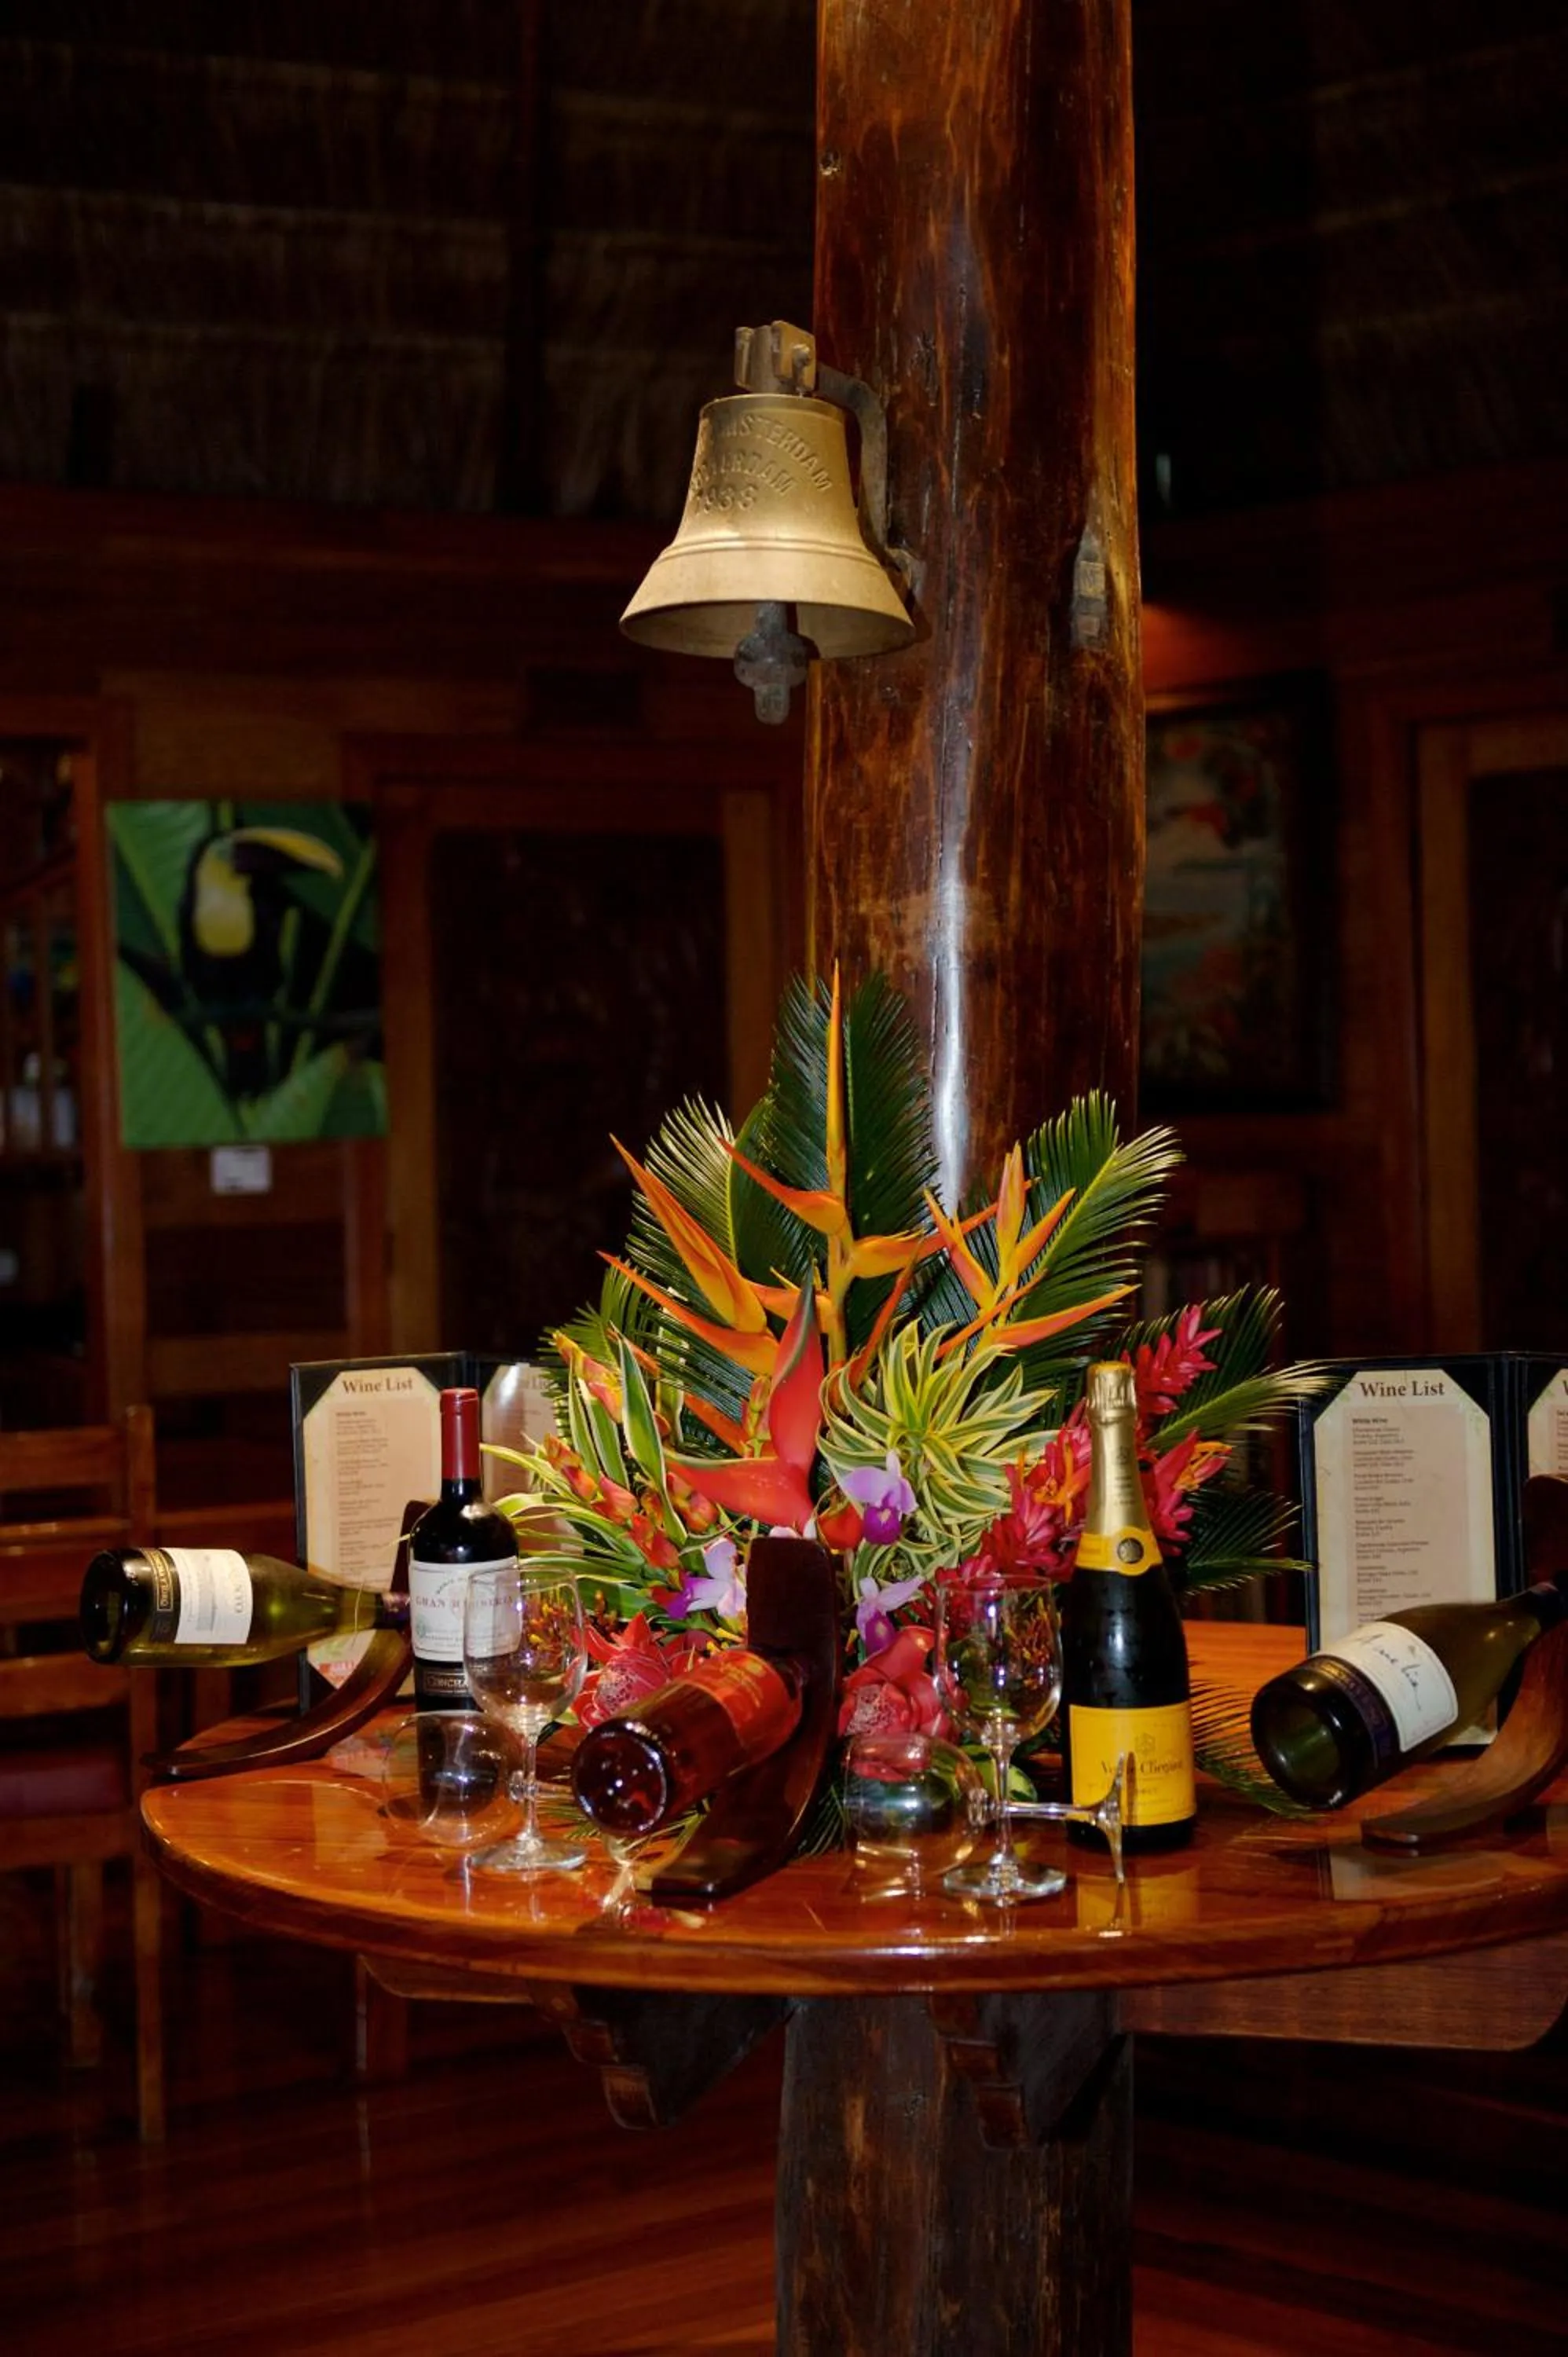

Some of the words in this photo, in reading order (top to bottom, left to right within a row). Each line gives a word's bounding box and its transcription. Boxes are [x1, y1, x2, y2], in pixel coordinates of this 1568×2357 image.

[342, 1380, 381, 1394] Wine
[386, 1376, 412, 1391] List
[1360, 1382, 1406, 1397] Wine
[1412, 1380, 1445, 1396] List
